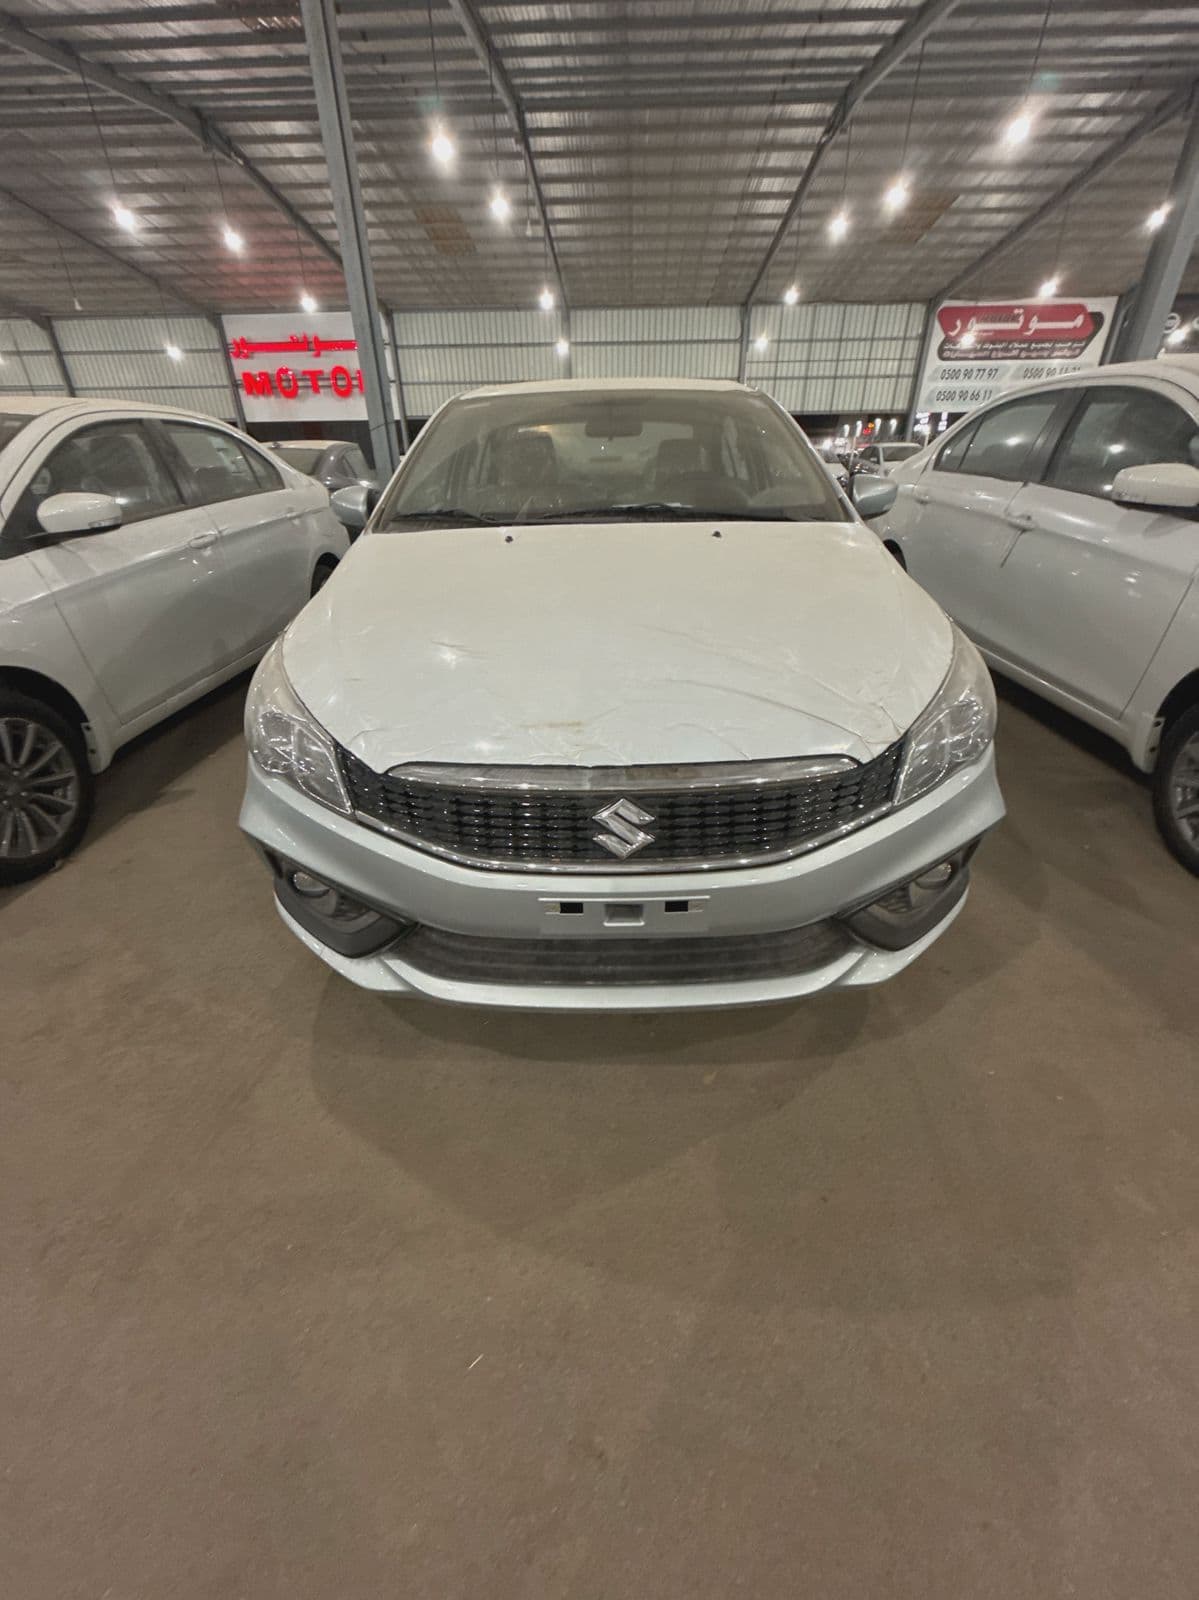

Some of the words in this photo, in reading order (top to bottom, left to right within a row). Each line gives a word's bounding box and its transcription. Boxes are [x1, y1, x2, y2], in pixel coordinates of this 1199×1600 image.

[948, 307, 1084, 336] موتور
[230, 331, 358, 360] وتور
[241, 365, 365, 400] MOTO
[940, 368, 960, 380] 0500
[962, 368, 973, 380] 90
[975, 368, 986, 380] 77
[987, 368, 999, 380] 97
[1023, 367, 1044, 379] 0500
[936, 390, 956, 402] 0500
[958, 390, 969, 402] 90
[970, 390, 980, 401] 66
[983, 389, 993, 401] 11
